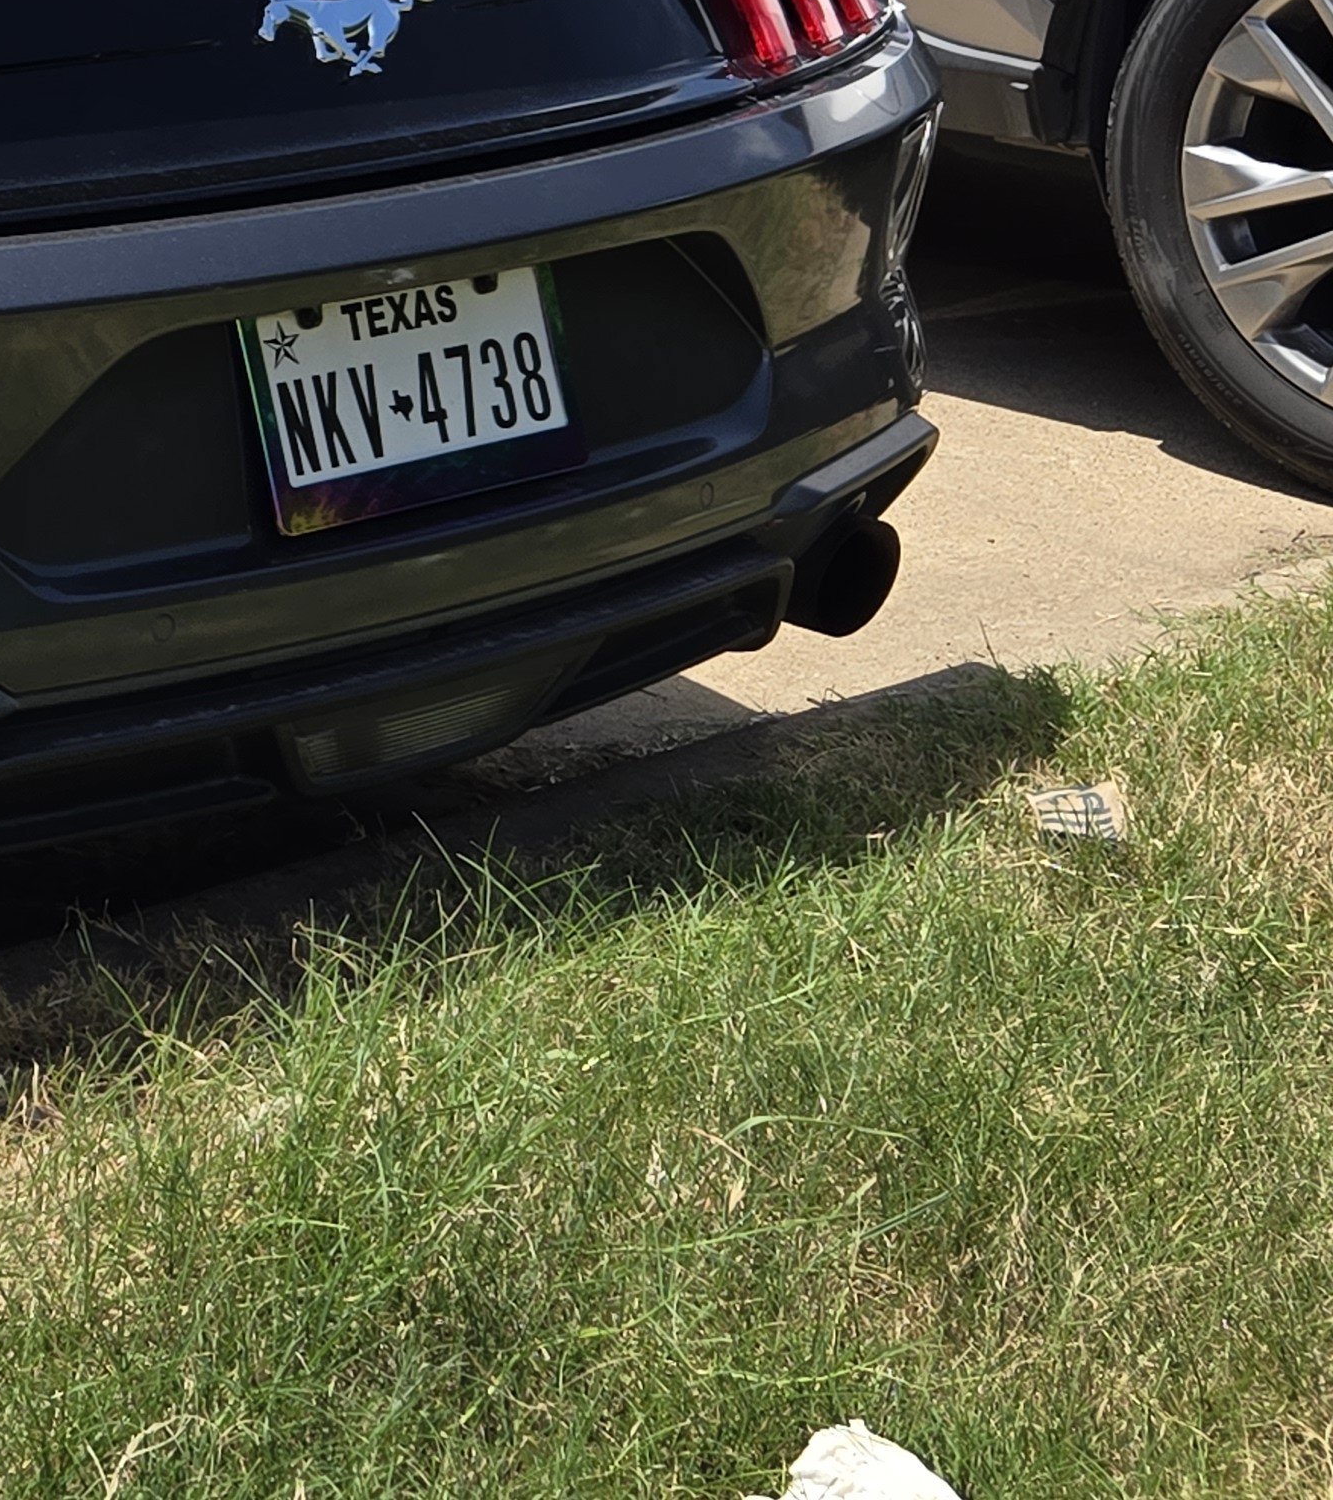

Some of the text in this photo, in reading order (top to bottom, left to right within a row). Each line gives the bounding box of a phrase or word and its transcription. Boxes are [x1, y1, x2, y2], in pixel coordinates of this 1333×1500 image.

[340, 285, 458, 341] TEXAS
[276, 332, 552, 476] NKV 4738
